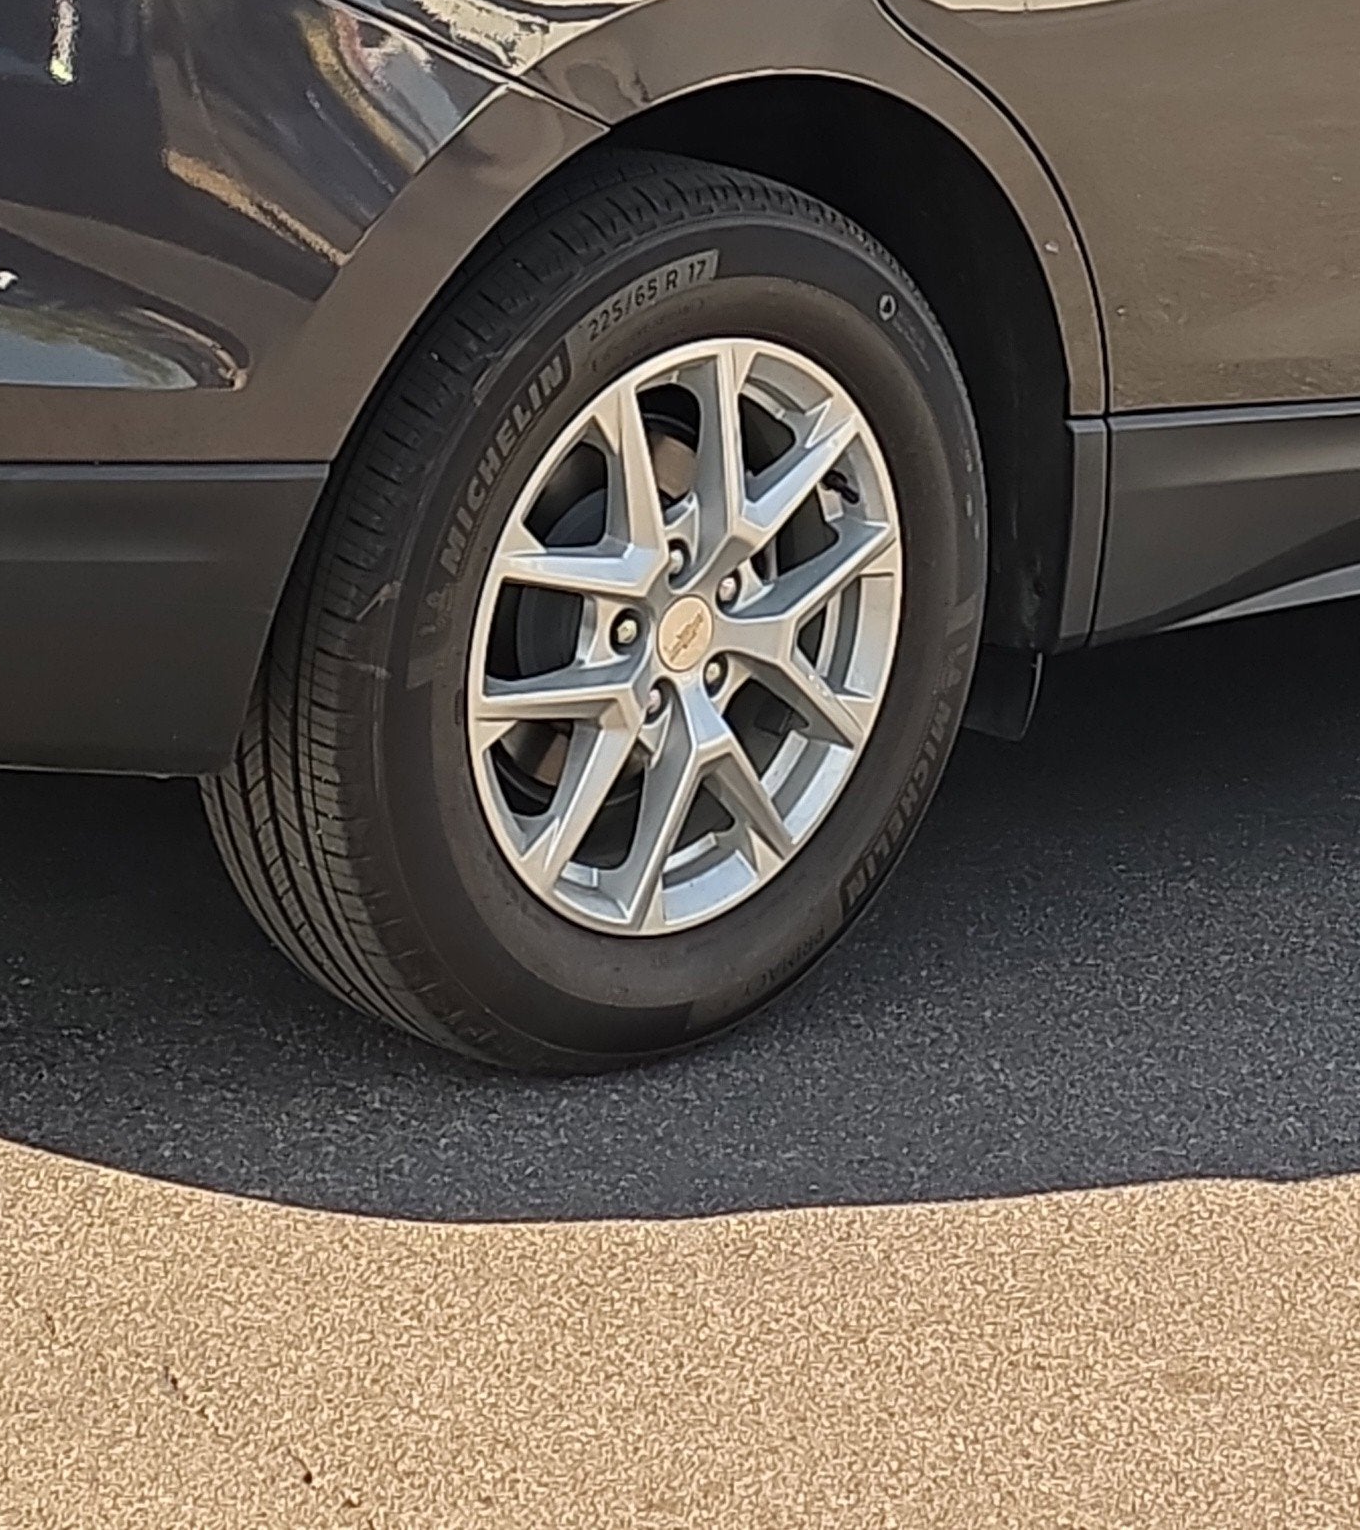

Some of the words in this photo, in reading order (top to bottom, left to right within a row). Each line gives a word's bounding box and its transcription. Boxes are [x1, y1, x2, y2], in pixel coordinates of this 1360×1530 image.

[588, 278, 658, 343] 225/65
[666, 268, 679, 292] R
[688, 258, 707, 284] 17
[440, 355, 565, 576] MICHELIN
[844, 701, 952, 908] MICHELIN
